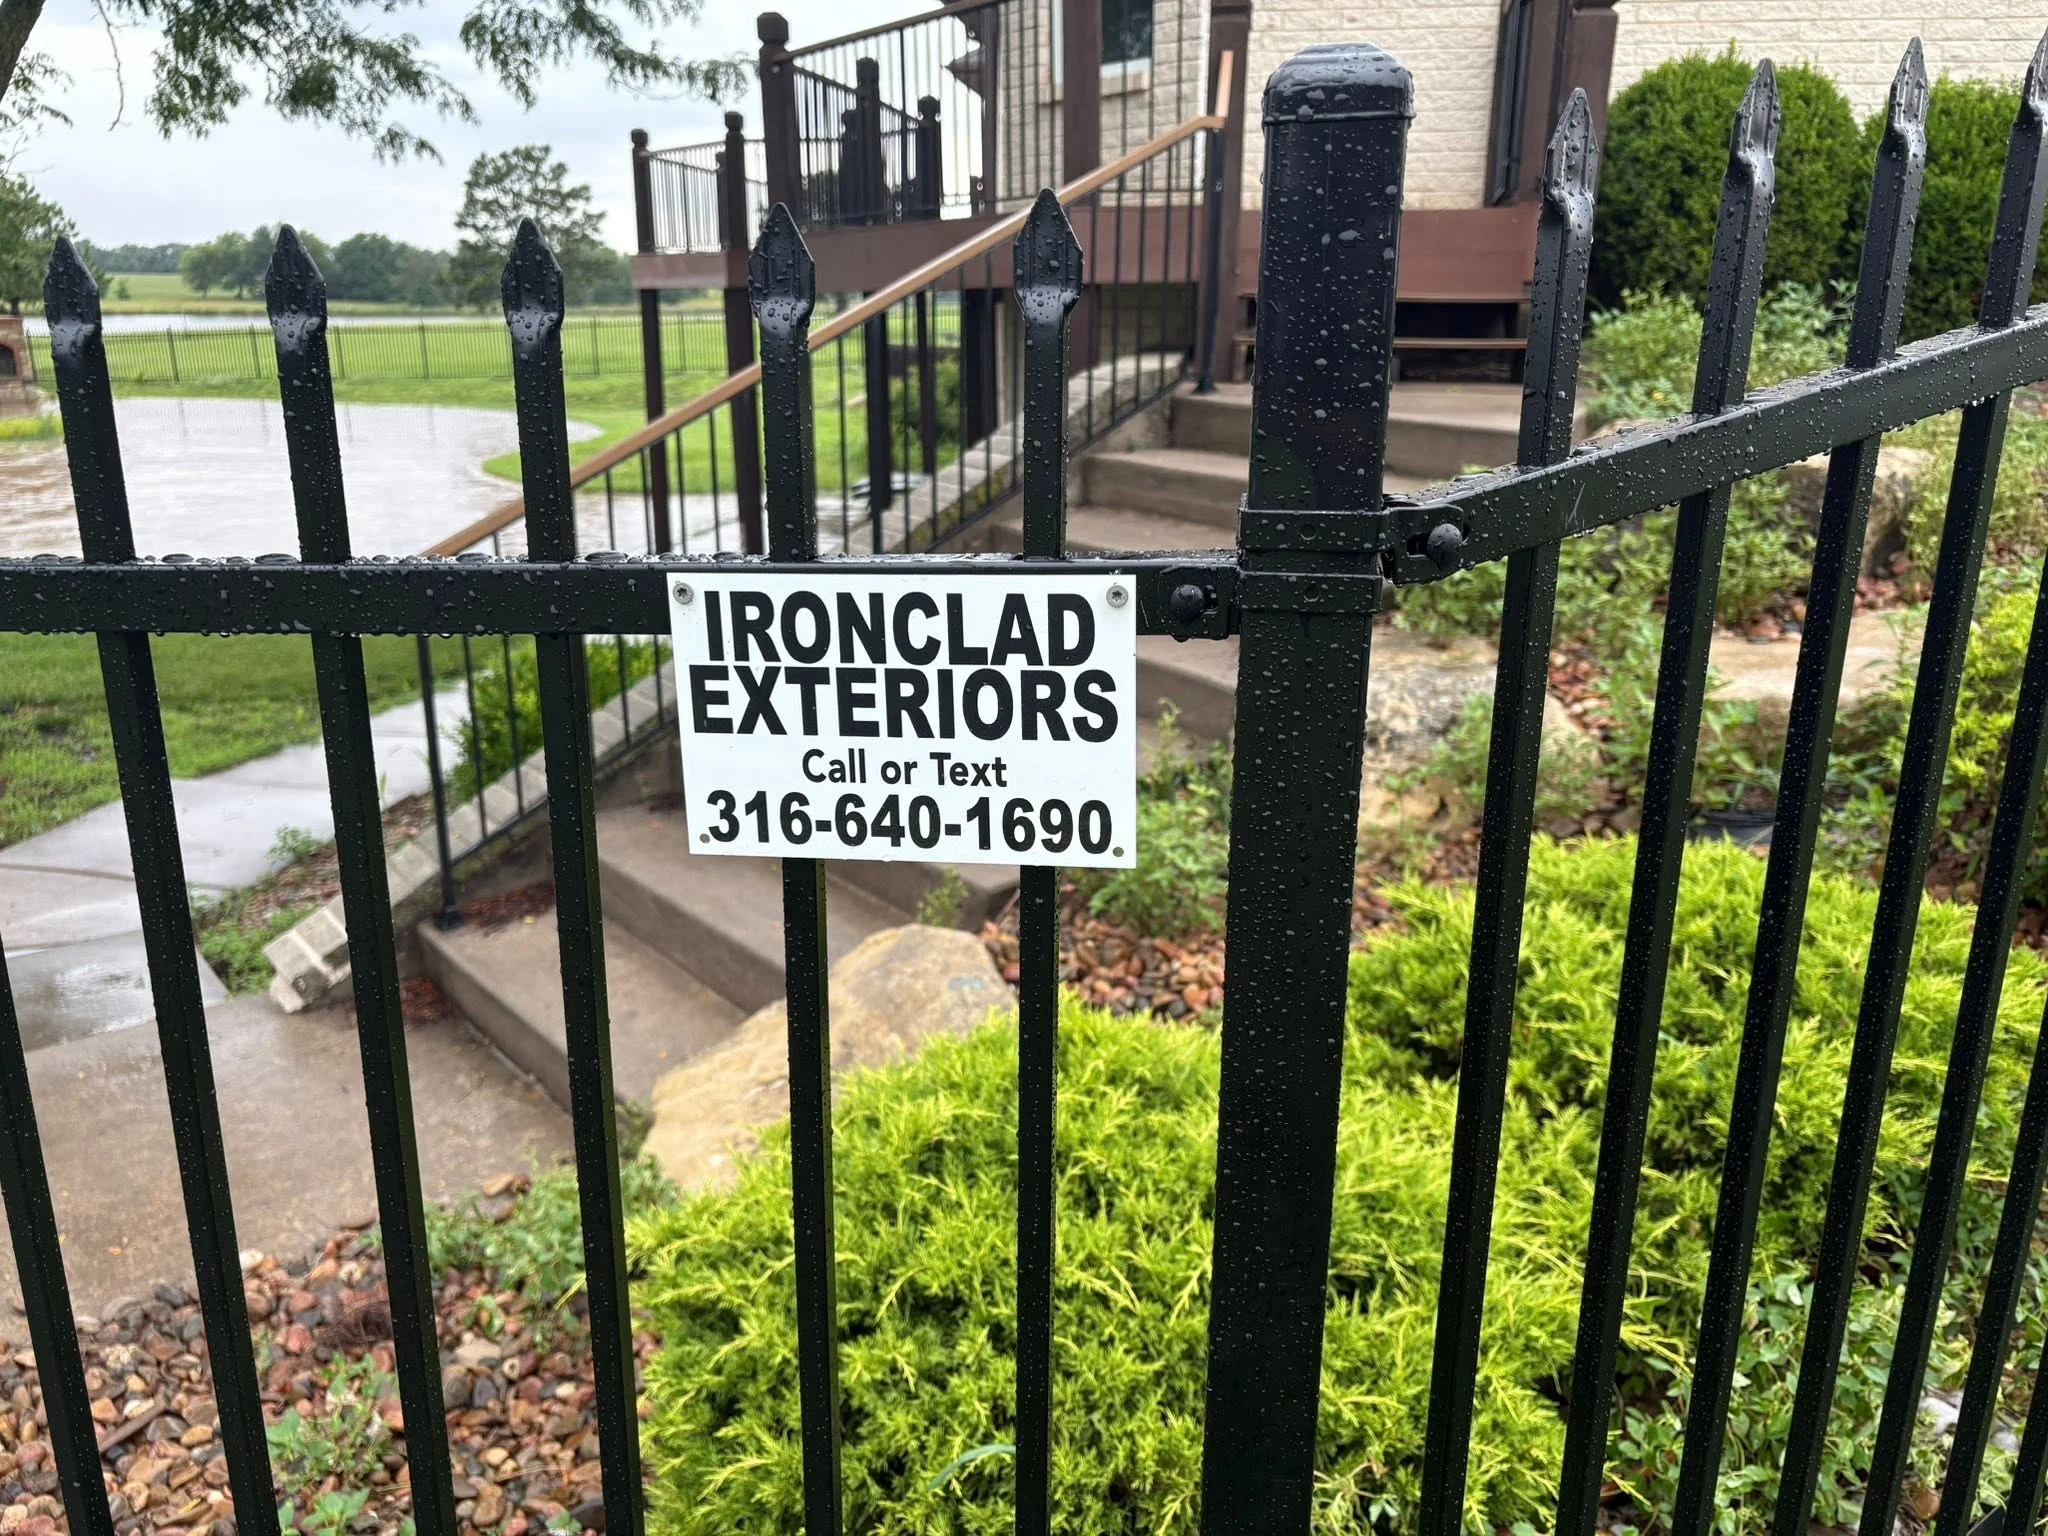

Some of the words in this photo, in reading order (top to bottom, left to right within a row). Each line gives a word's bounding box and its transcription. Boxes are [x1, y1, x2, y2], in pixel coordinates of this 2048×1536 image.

[704, 590, 1096, 667] IRONCLAD
[689, 664, 1119, 743] EXTERIORS
[802, 748, 867, 784] Call
[880, 760, 918, 785] or
[929, 751, 1008, 788] Text
[706, 789, 1112, 855] 316-640-1690
